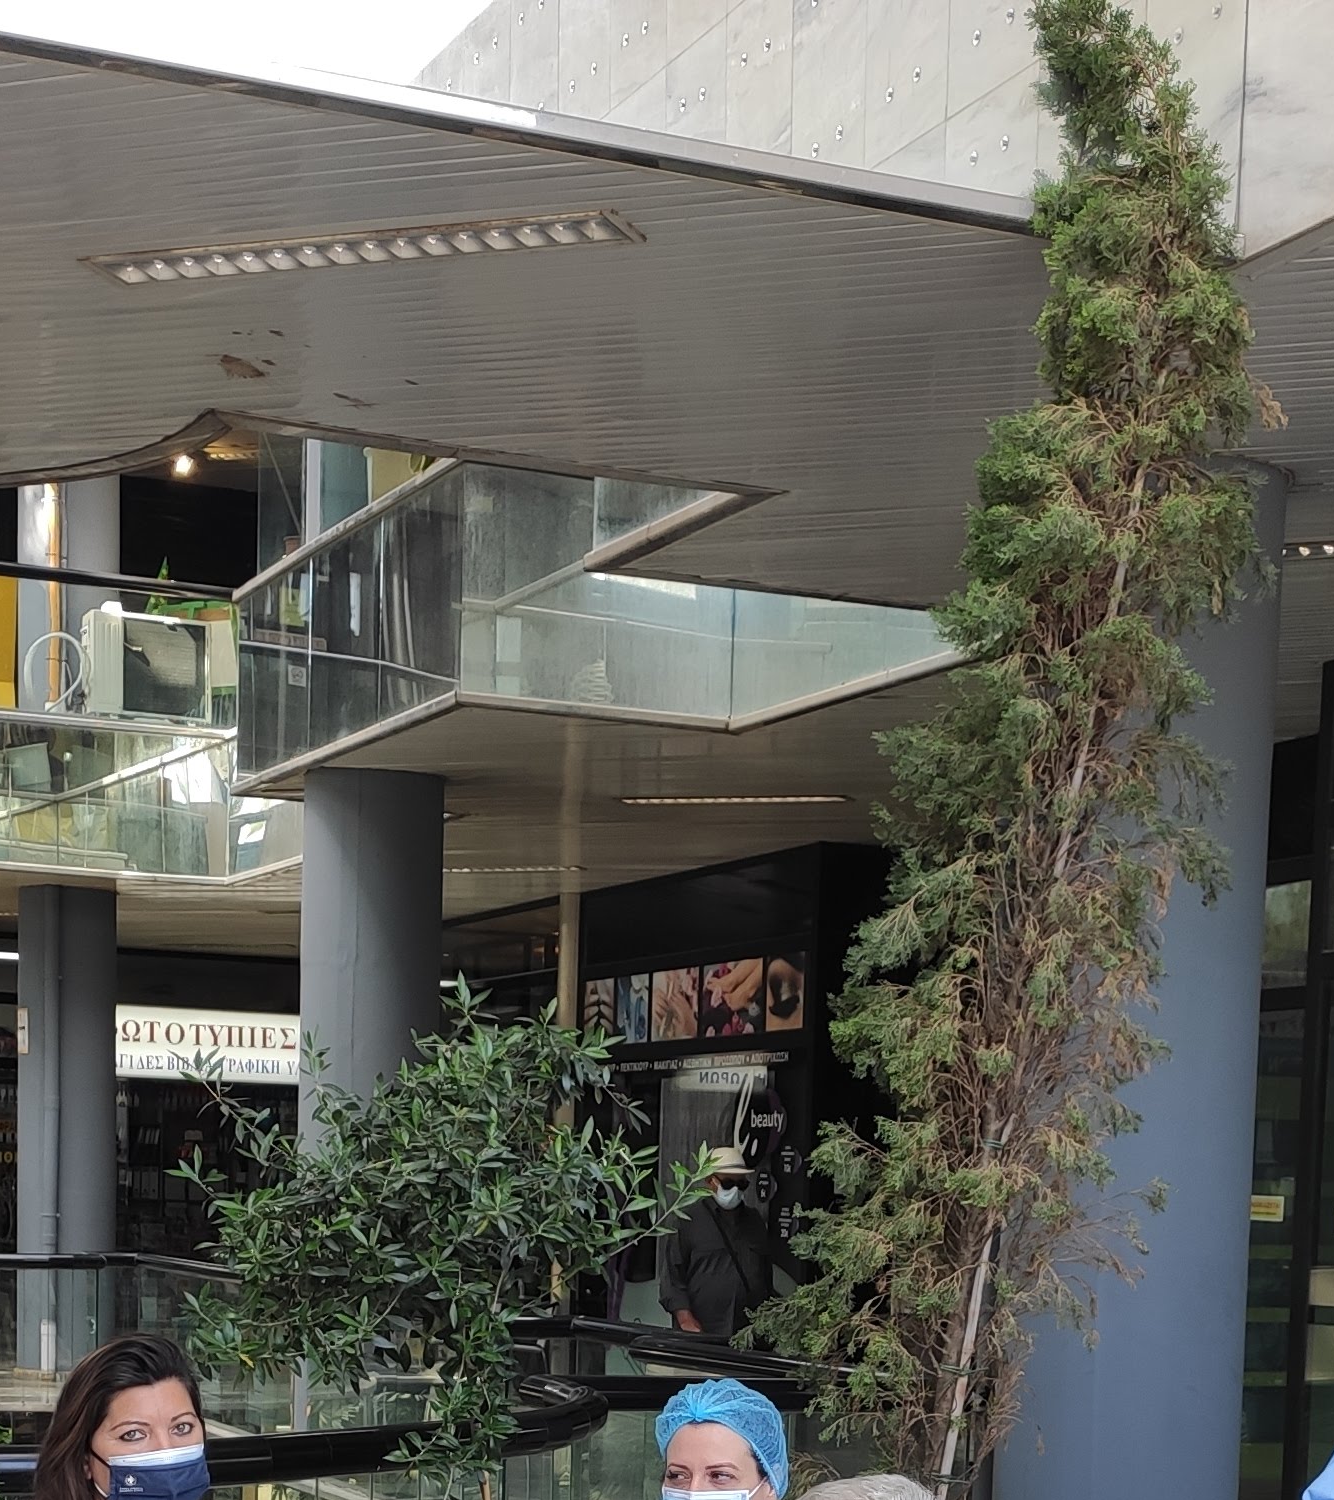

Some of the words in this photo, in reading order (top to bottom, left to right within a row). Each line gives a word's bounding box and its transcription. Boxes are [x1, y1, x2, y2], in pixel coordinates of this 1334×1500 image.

[120, 1019, 297, 1050] ΩΤΟΤΥΠΙΕΣ
[118, 1053, 164, 1070] ΓΙΔΕΣ
[227, 1058, 281, 1075] ΡΑΦΙΚΗ
[750, 1109, 784, 1133] beauty
